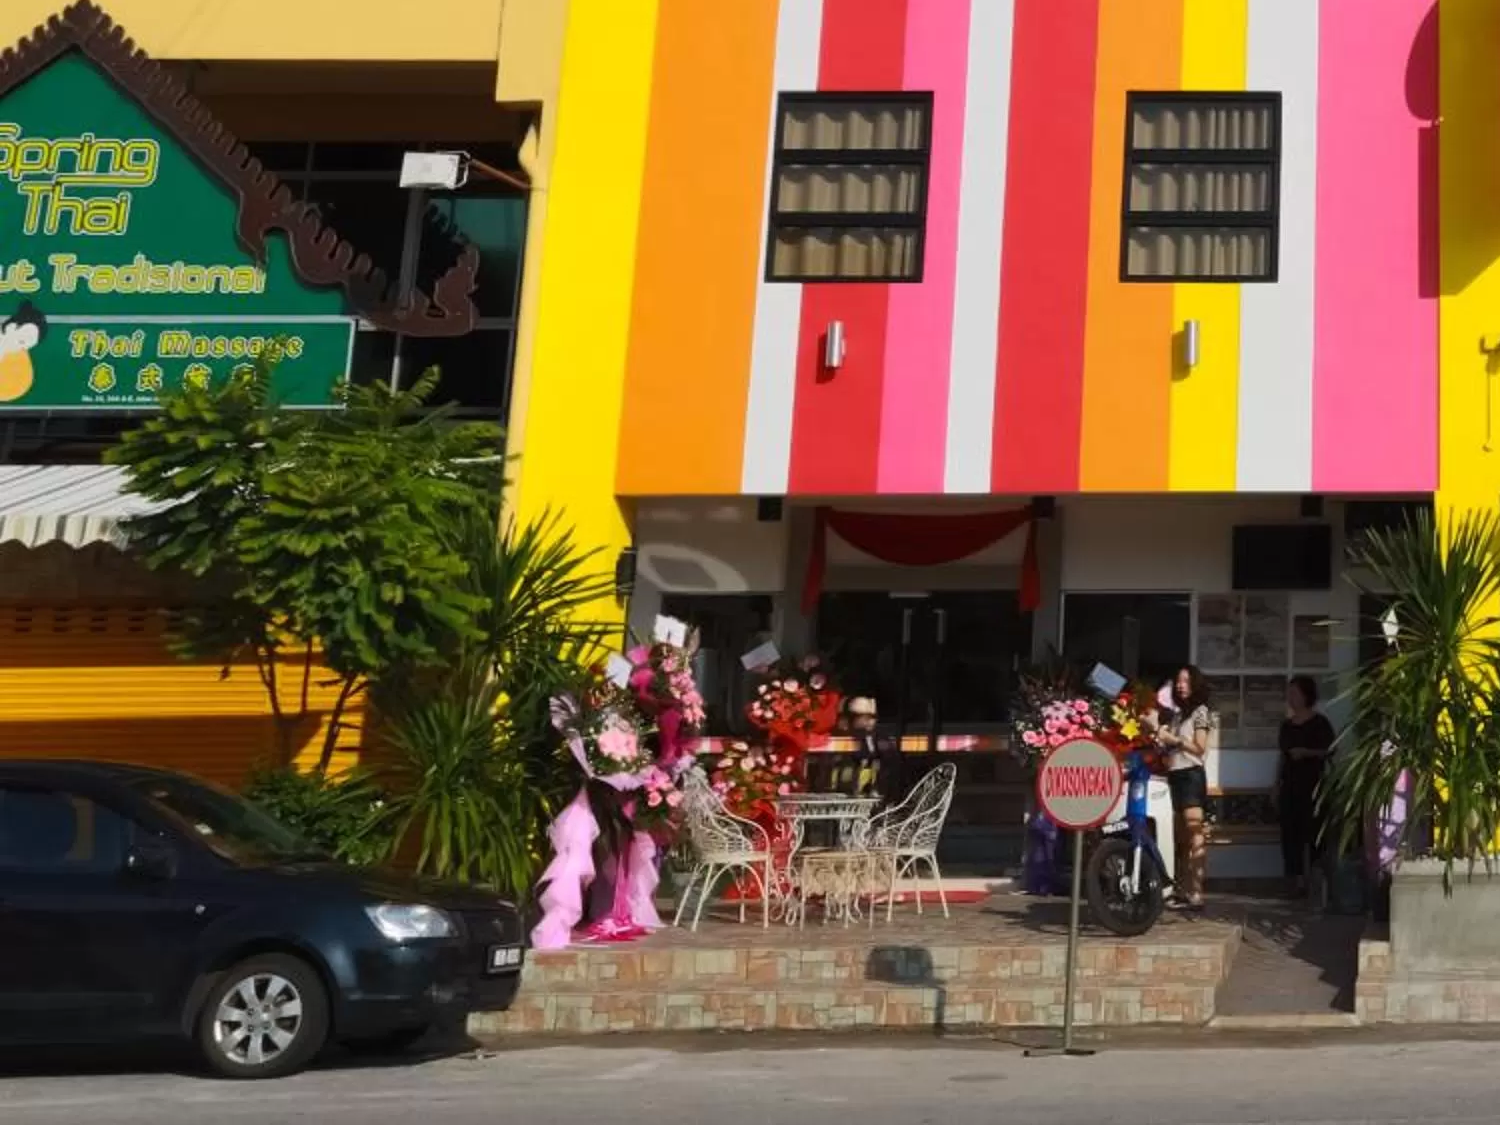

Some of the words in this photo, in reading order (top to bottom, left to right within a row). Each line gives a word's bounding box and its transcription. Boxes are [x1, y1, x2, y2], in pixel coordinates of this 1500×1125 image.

[18, 181, 132, 235] Thai
[48, 251, 266, 293] Tradisional
[68, 329, 145, 360] Thai
